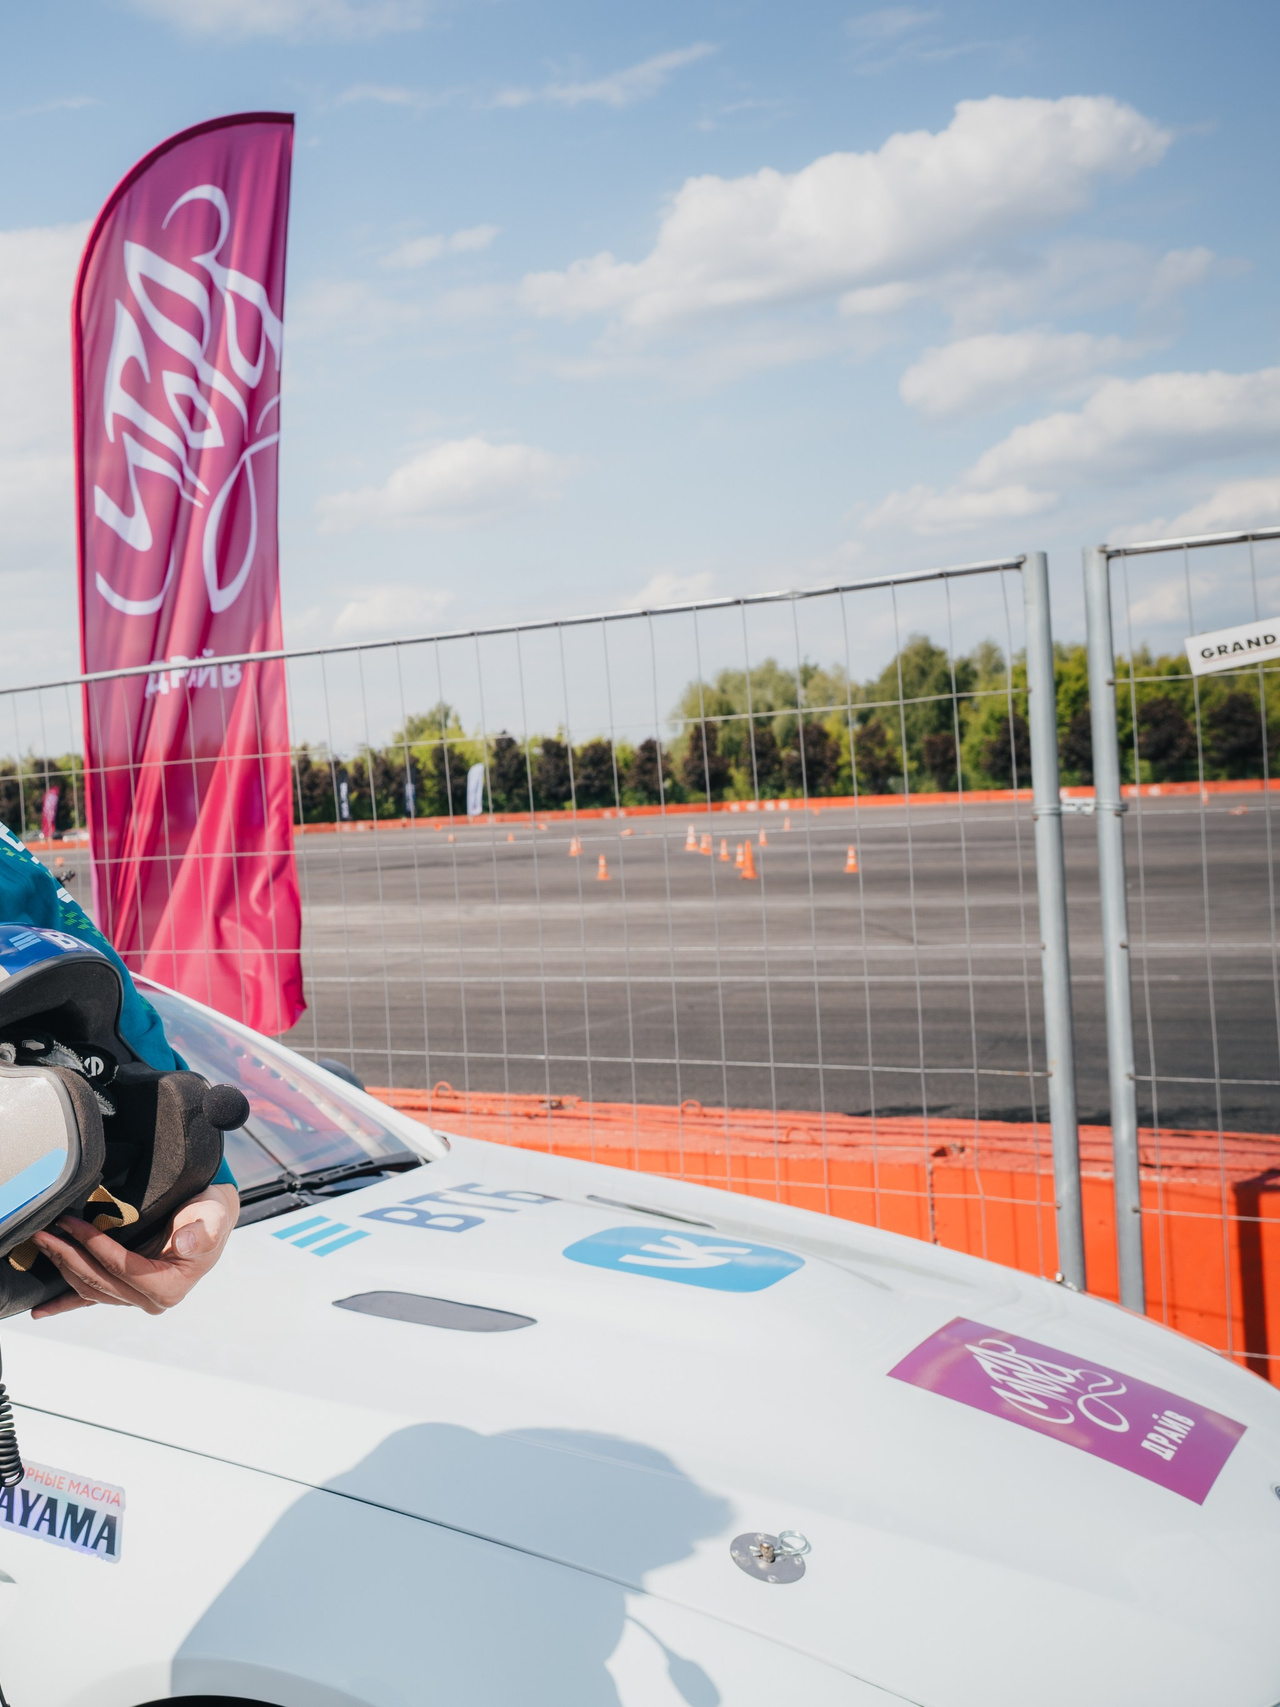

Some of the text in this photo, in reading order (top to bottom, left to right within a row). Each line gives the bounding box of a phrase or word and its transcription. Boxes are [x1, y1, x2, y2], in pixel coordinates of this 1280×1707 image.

[1200, 634, 1277, 659] GRAND
[1140, 1410, 1196, 1461] ДРАЙВ
[66, 1479, 121, 1507] МАСЛА
